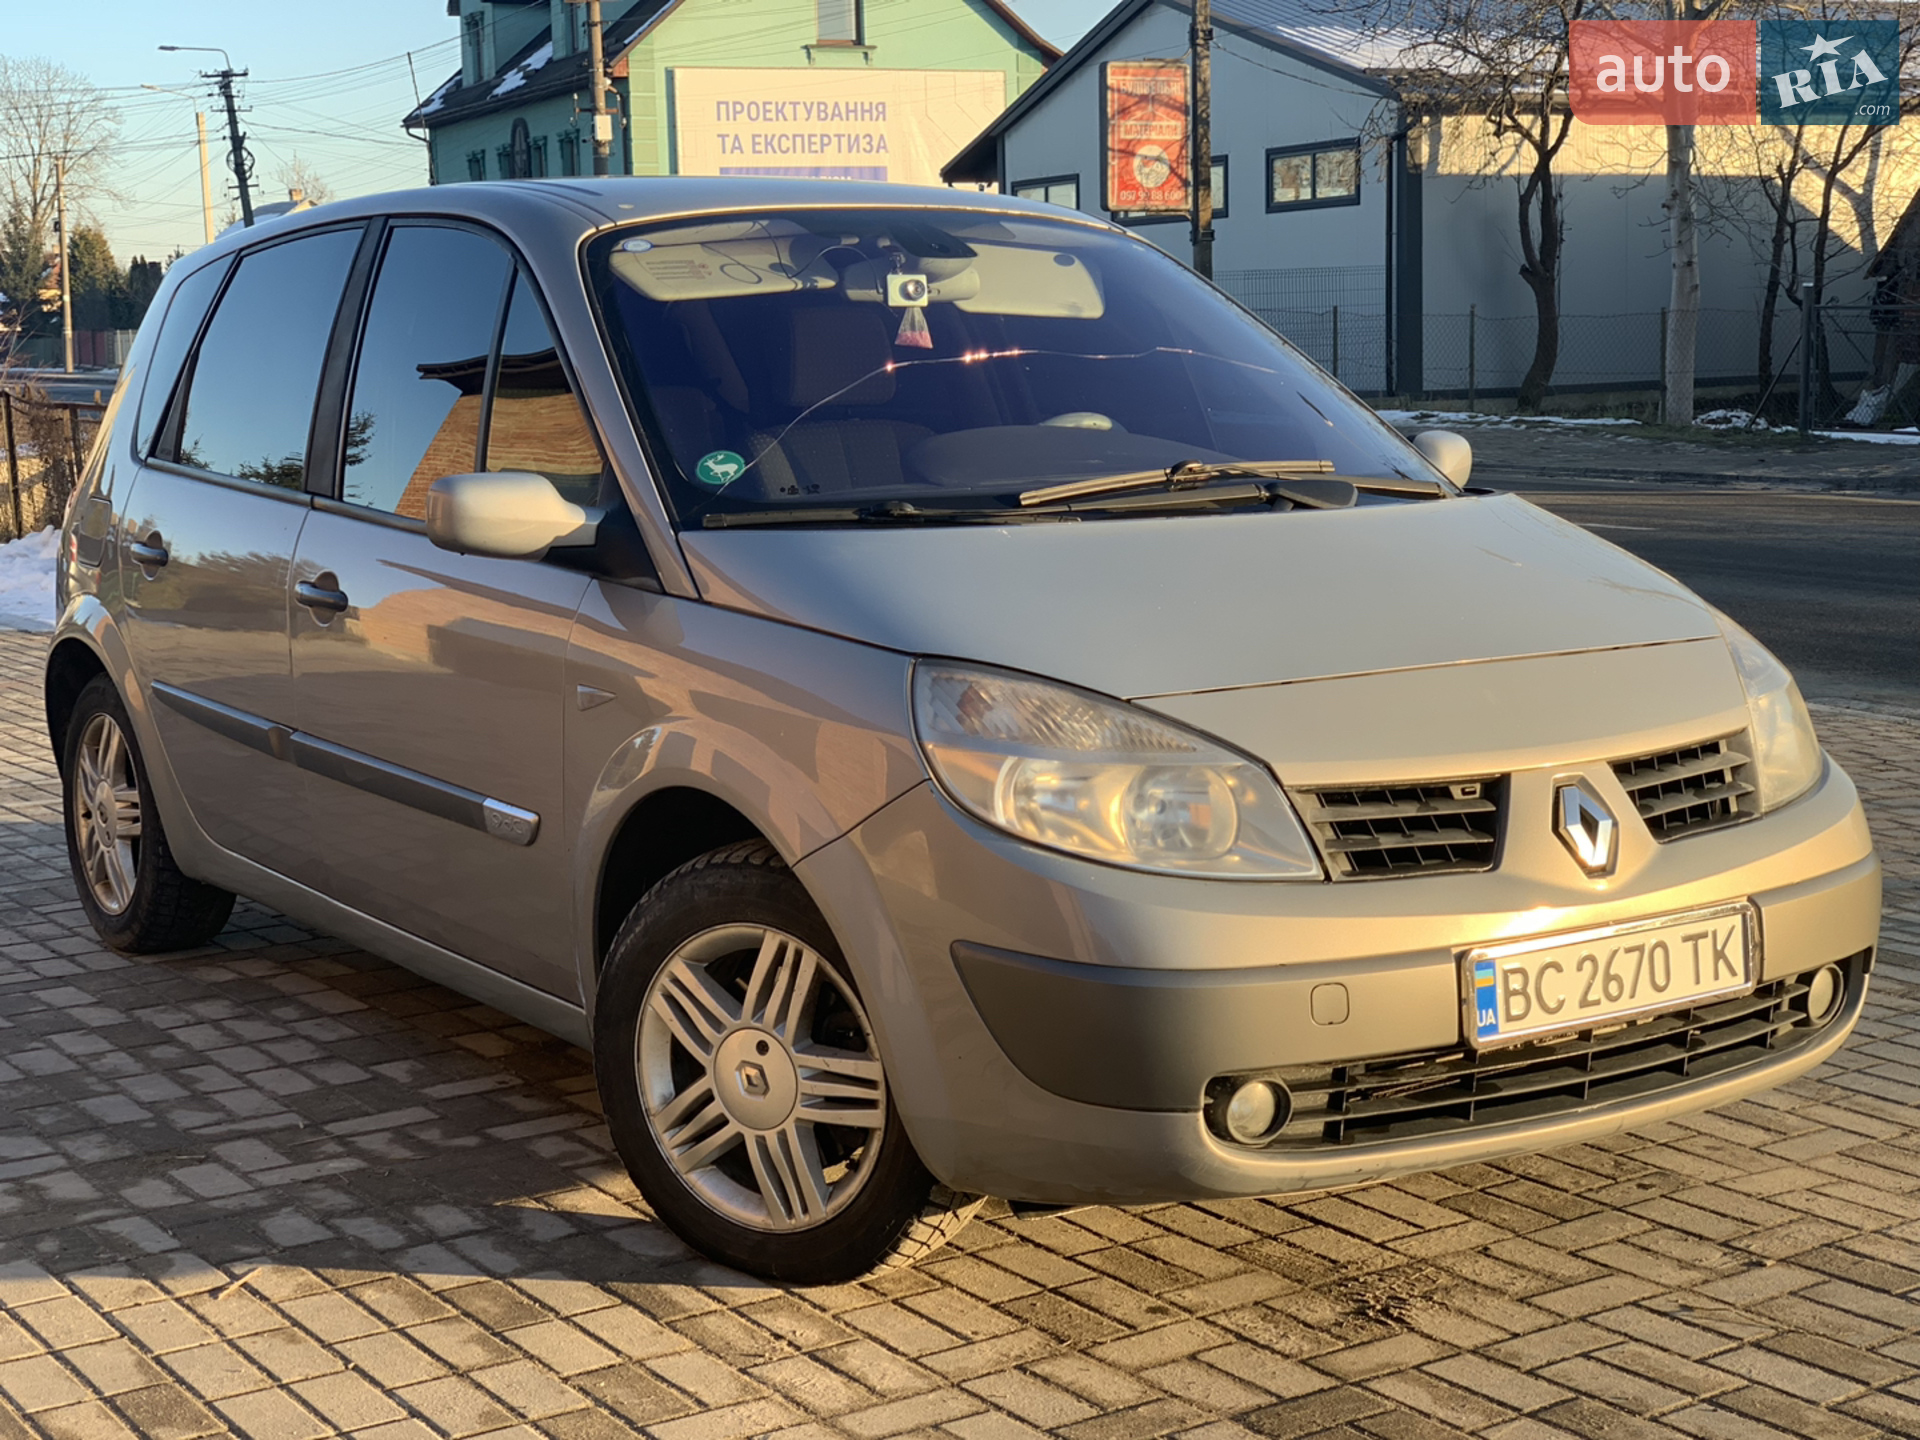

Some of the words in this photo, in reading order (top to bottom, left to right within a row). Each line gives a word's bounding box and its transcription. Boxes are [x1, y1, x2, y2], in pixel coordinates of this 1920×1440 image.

[1119, 80, 1182, 96] БУДІВЕЛЬНІ
[715, 100, 888, 123] ПРОЕКТУВАННЯ
[716, 133, 745, 155] ТА
[750, 133, 889, 155] ЕКСПЕРТИЗА
[1501, 959, 1567, 1023] BC
[1576, 938, 1672, 1010] 2670
[1681, 923, 1739, 987] TK
[1476, 1008, 1497, 1028] UA
